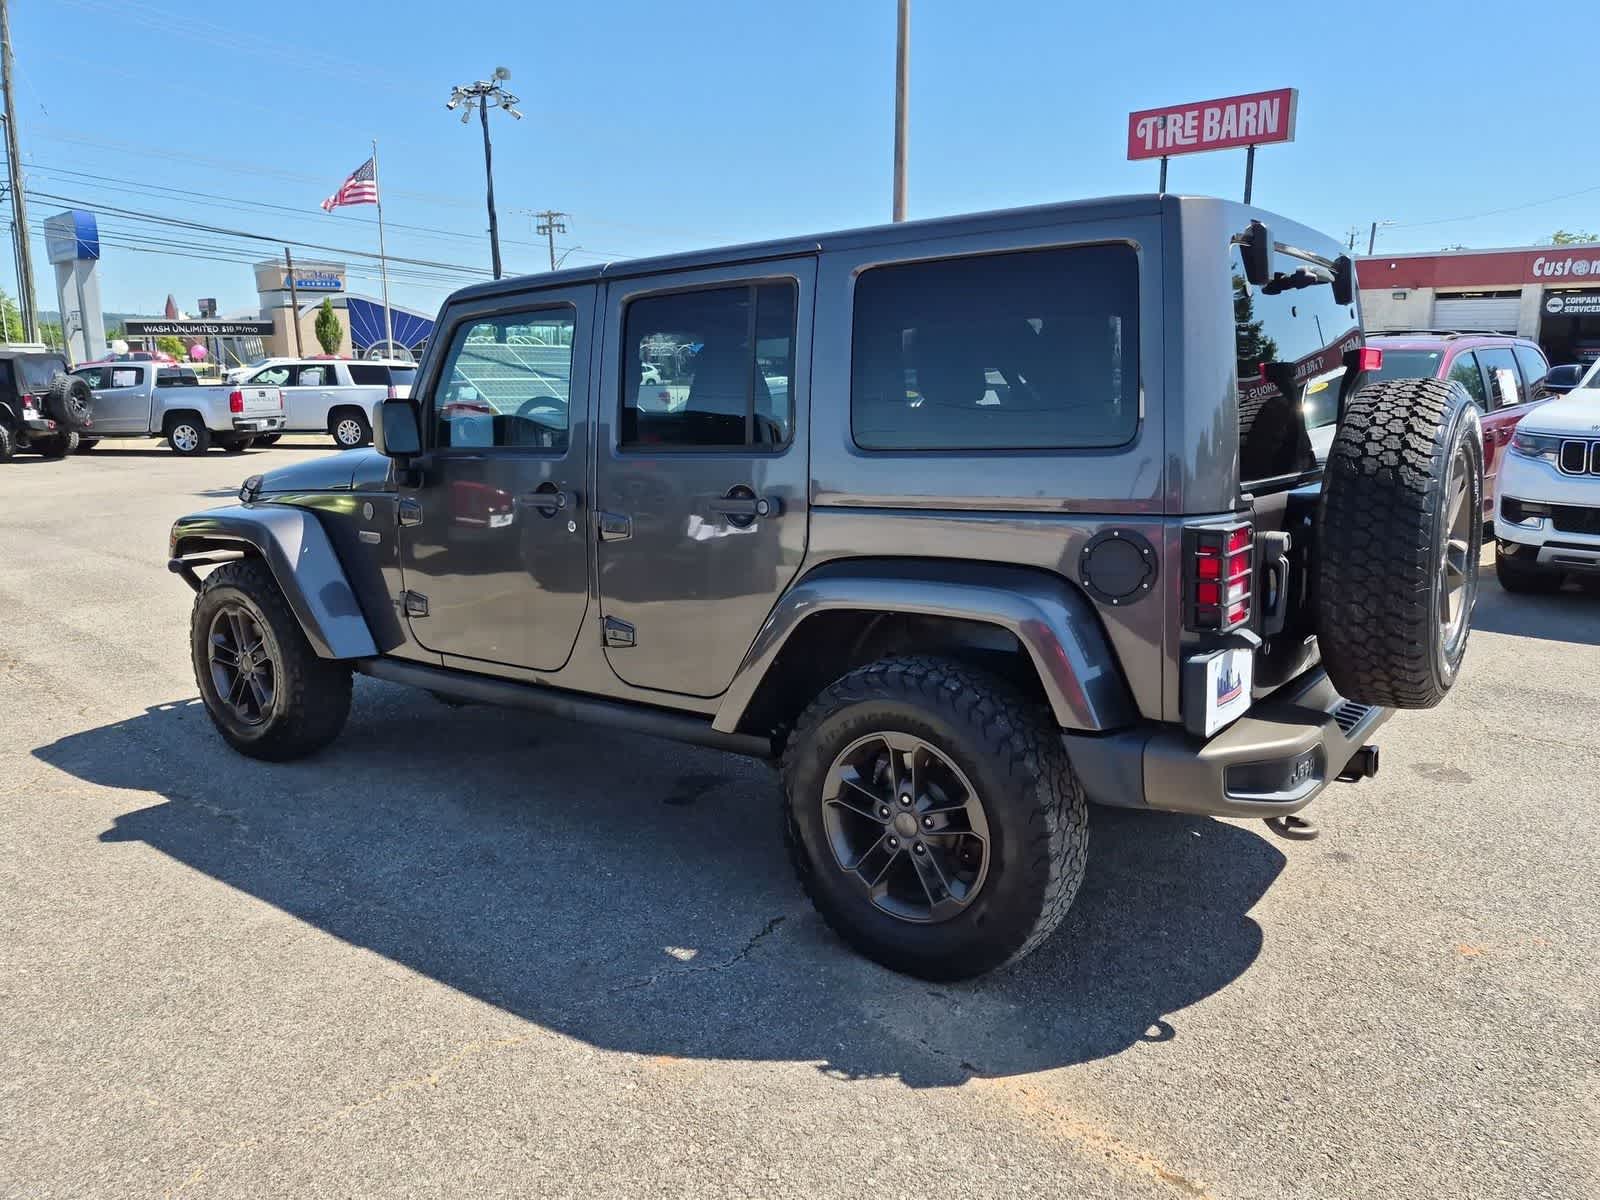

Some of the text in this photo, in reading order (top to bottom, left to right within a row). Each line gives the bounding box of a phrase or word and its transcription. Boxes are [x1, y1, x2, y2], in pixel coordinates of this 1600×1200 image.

[1203, 98, 1280, 142] BARN
[144, 325, 170, 334] WASH
[173, 325, 218, 334] UNLIMITED
